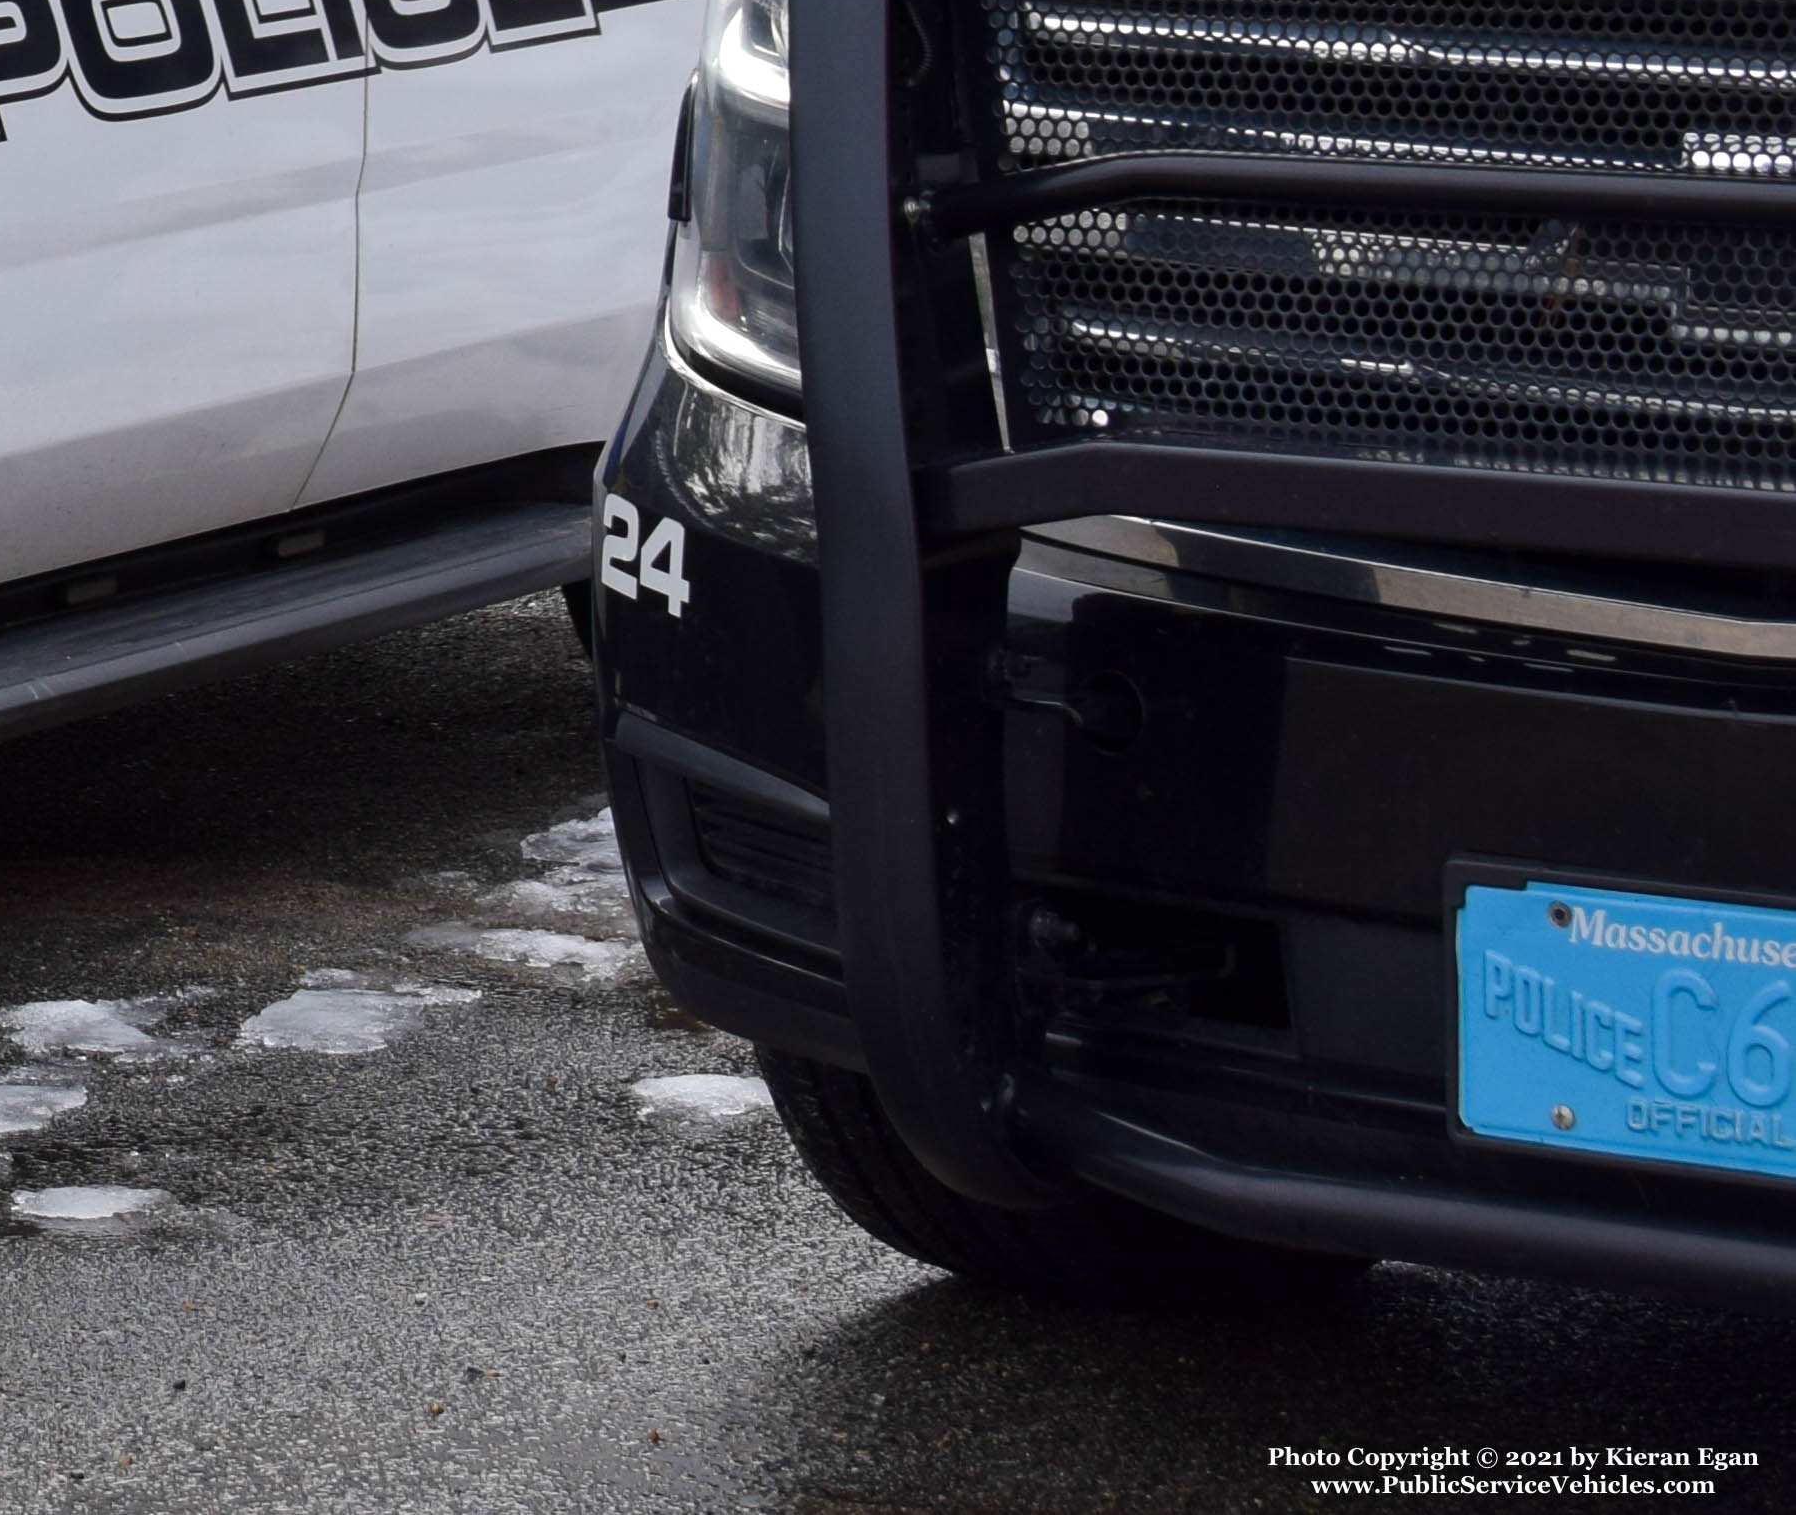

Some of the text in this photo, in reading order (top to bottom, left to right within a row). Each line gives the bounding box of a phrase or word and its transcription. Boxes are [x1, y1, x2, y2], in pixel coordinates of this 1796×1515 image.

[601, 493, 690, 618] 24
[1483, 948, 1793, 1110] POLICE C6
[1626, 1094, 1796, 1152] OFFICIAL
